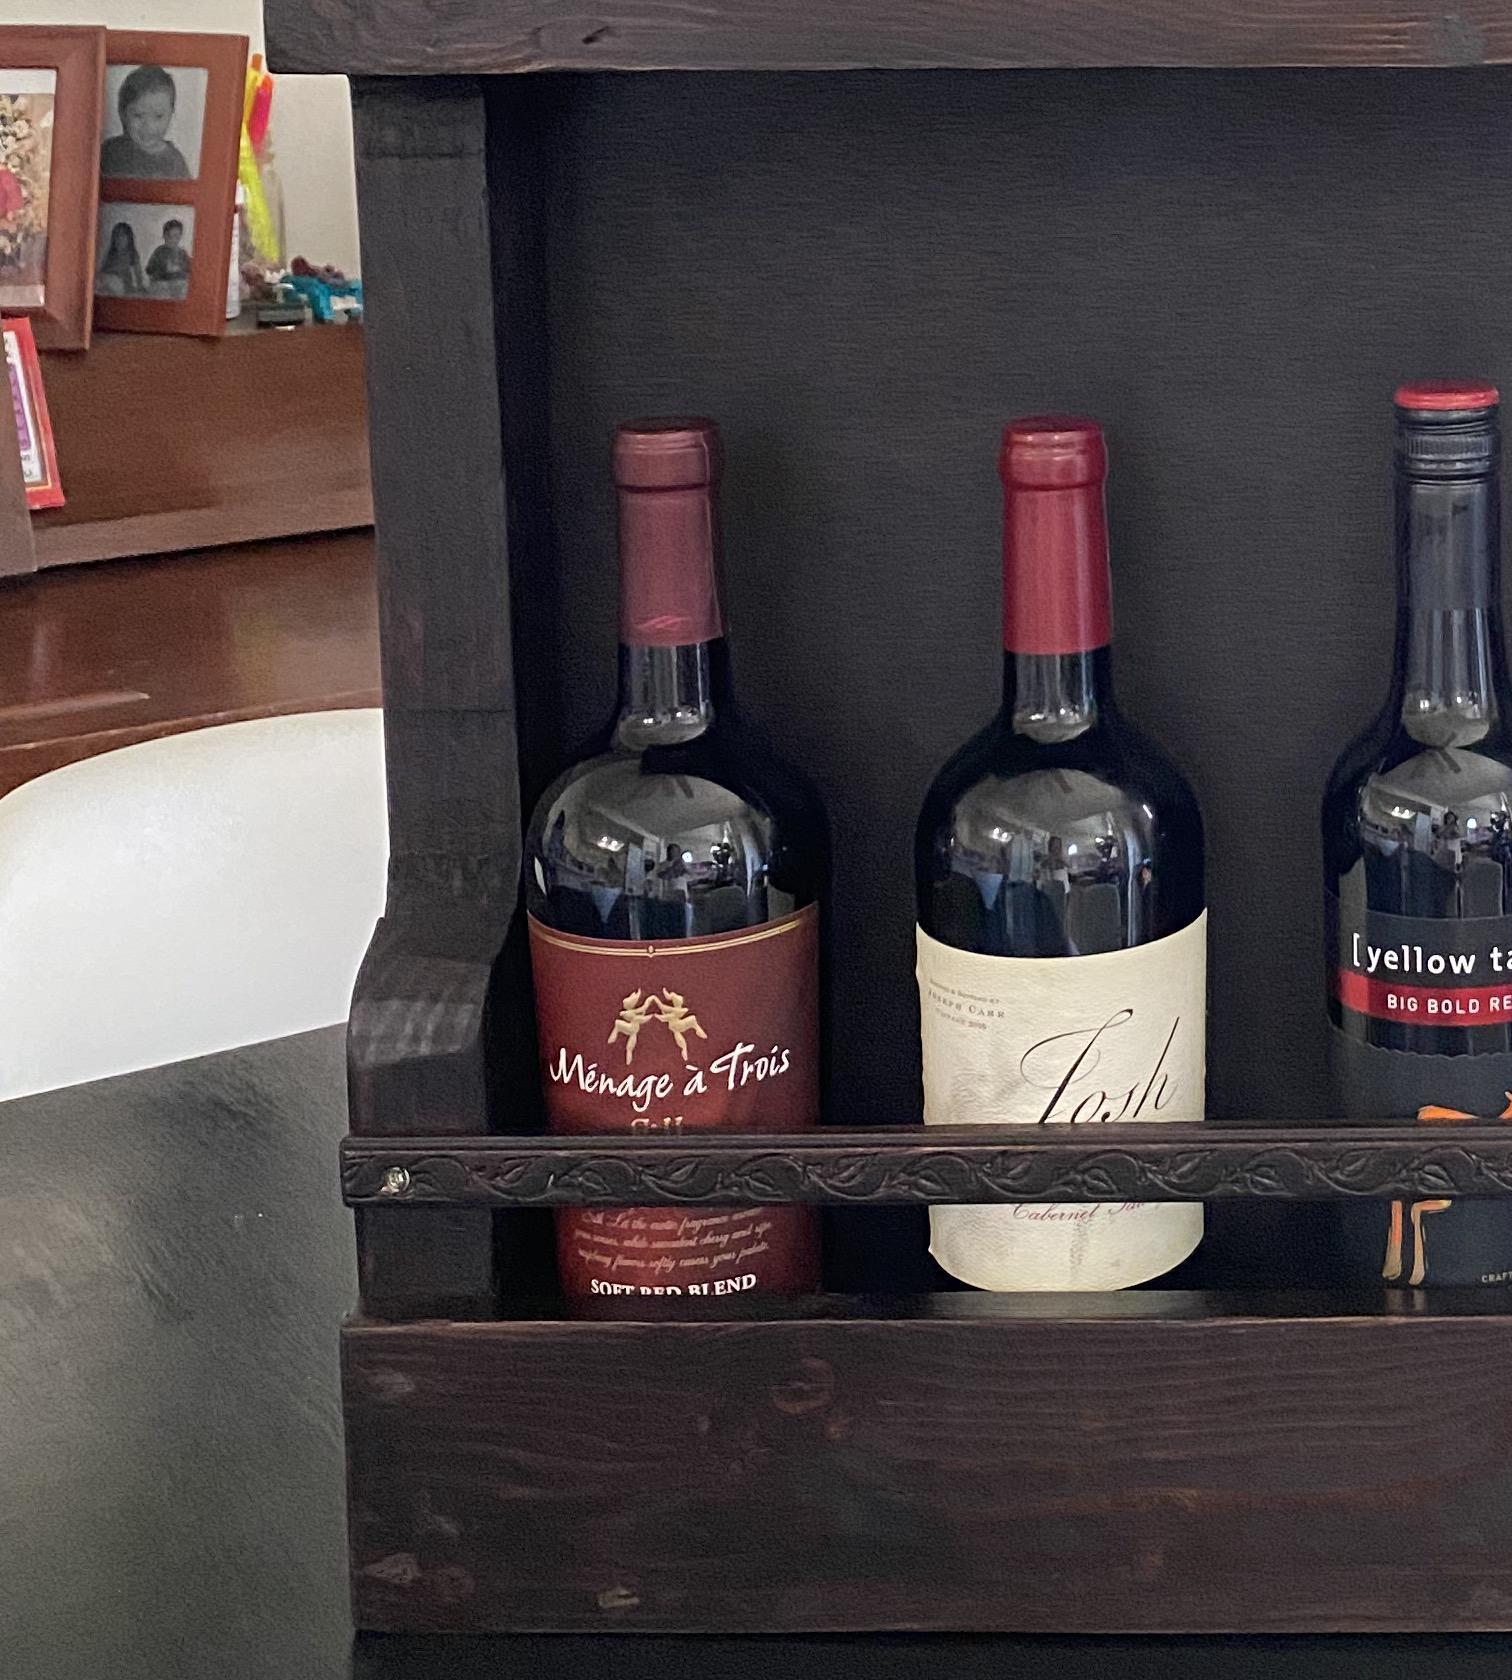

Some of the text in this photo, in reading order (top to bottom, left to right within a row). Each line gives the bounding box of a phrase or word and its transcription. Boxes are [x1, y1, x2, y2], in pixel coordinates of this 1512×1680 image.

[968, 1004, 1006, 1018] CARR
[1387, 992, 1418, 1012] BIG
[1427, 998, 1480, 1015] BOLD
[550, 1042, 790, 1113] Ménage à Trois
[1020, 1007, 1179, 1125] Josh
[1013, 1202, 1100, 1221] Cabernet
[590, 1278, 636, 1296] SOFT
[687, 1273, 757, 1296] BLEND
